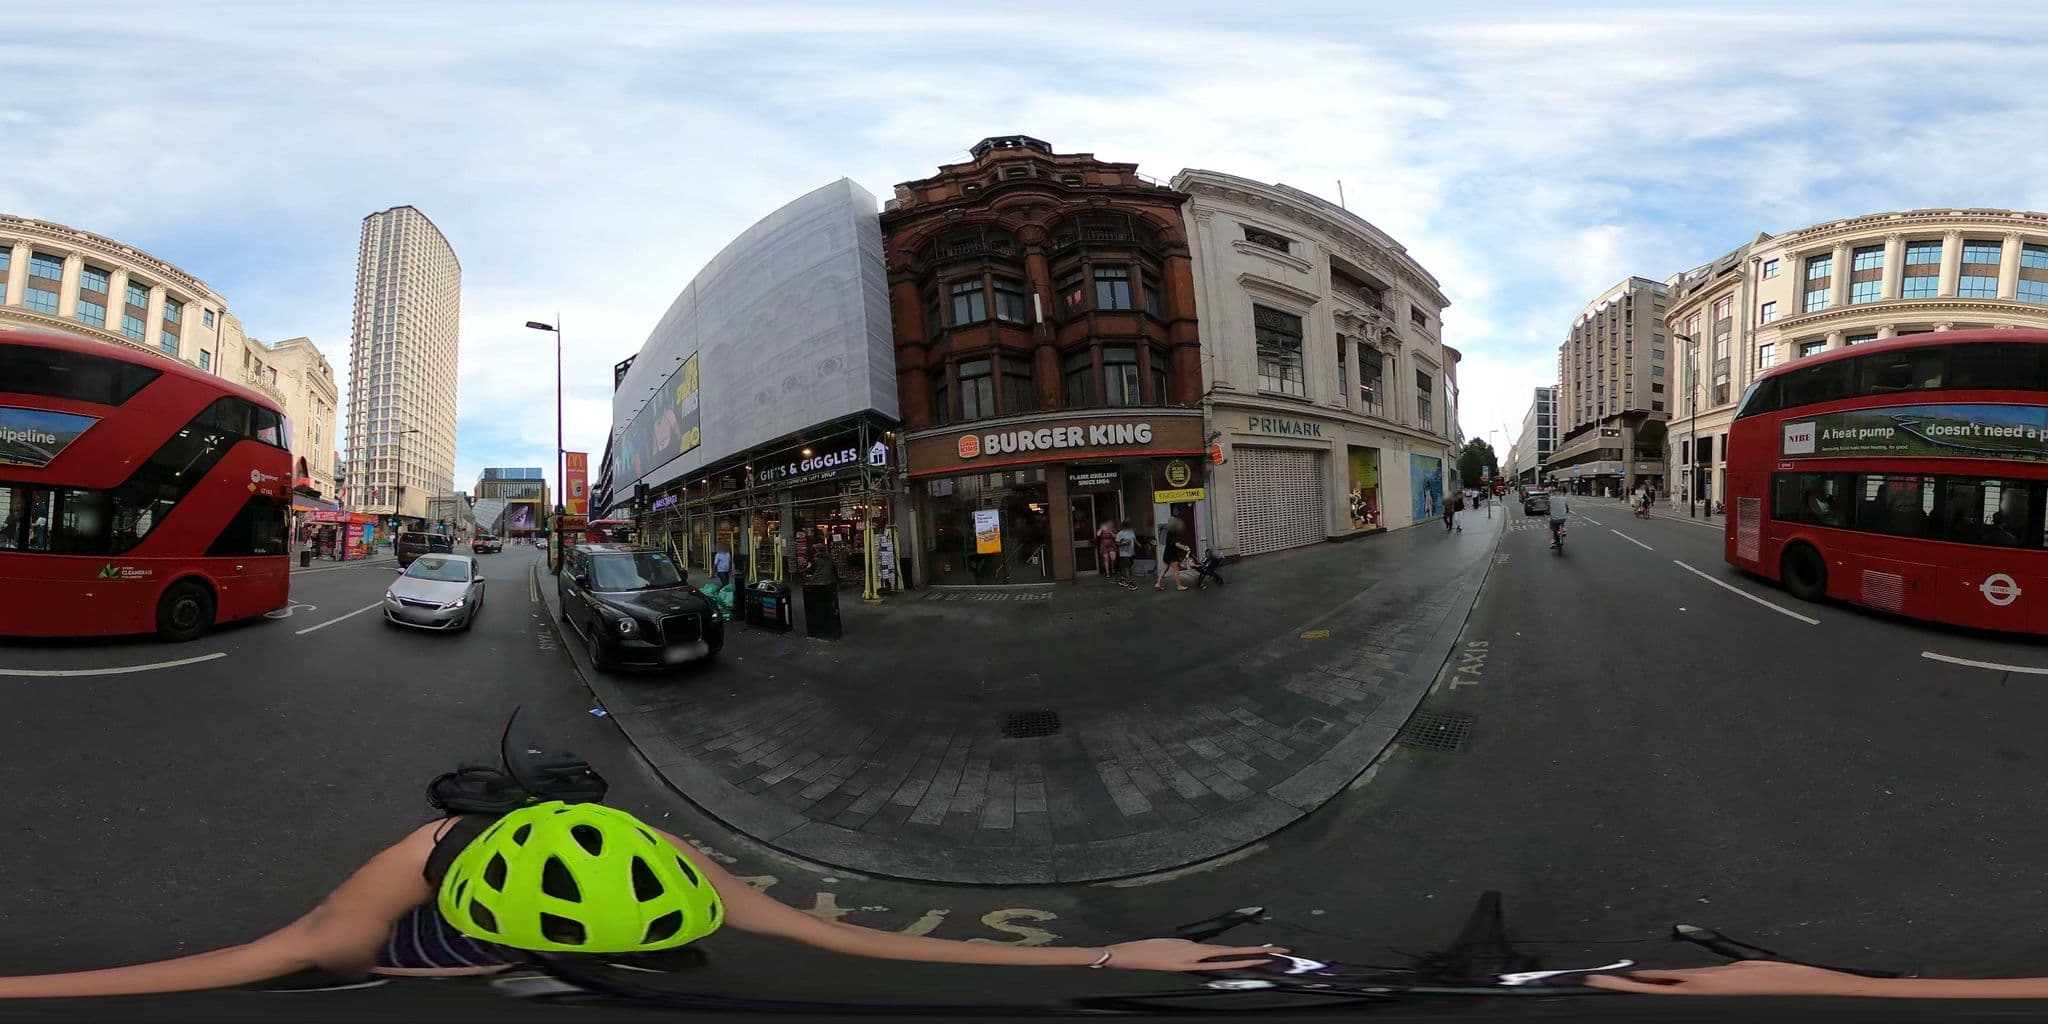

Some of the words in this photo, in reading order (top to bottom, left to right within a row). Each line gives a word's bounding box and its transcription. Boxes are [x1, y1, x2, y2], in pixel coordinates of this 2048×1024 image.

[983, 426, 1085, 455] BURGER
[1089, 423, 1153, 446] KING
[1248, 416, 1322, 438] PRIMARK
[1788, 433, 1811, 443] NIBE
[1822, 429, 1831, 440] A
[1832, 428, 1857, 439] heat
[1859, 427, 1895, 440] pump
[1926, 422, 1981, 436] doesn't
[1984, 425, 2023, 438] need
[2027, 428, 2036, 439] a
[789, 463, 798, 475] &
[801, 448, 858, 472] GIGGLES
[1448, 641, 1489, 690] TAXIS
